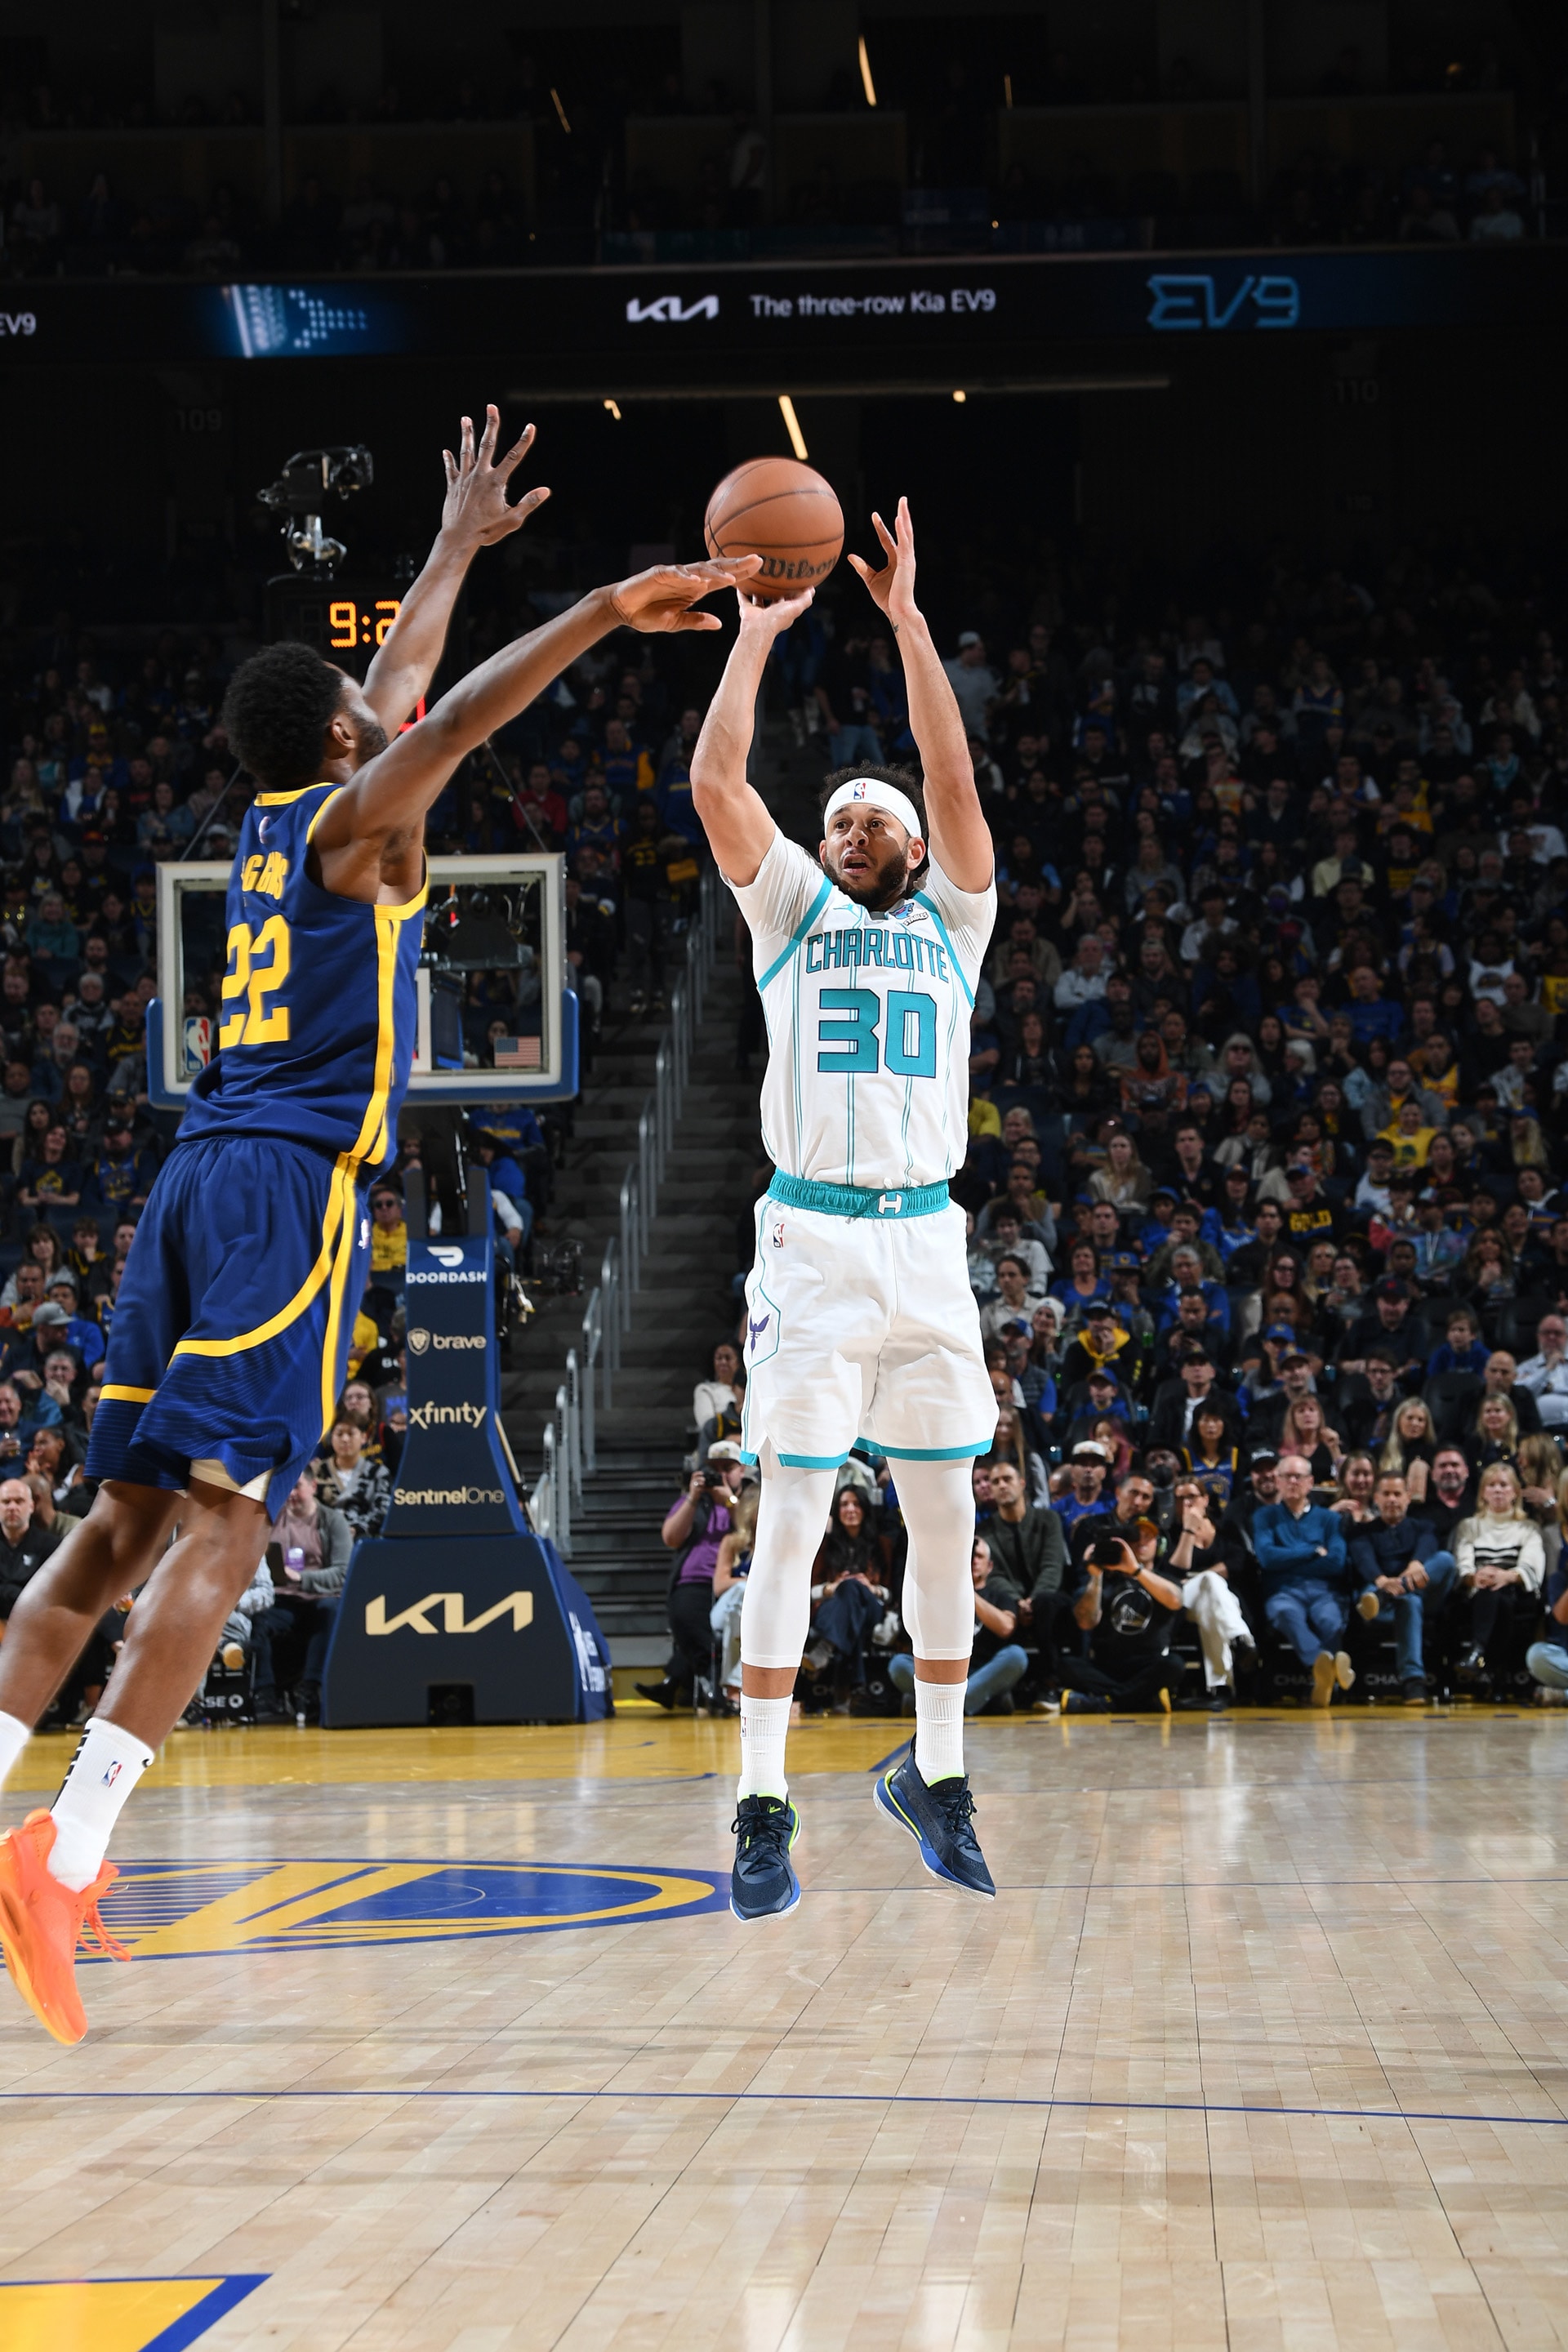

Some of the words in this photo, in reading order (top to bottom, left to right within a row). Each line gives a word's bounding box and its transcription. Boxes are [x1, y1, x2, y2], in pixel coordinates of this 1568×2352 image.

[751, 295, 792, 317] The
[797, 294, 905, 316] three-row
[910, 291, 946, 312] Kia
[951, 288, 996, 312] EV9
[1147, 274, 1298, 328] EV9
[176, 408, 222, 433] 109
[757, 555, 838, 580] Wilson
[329, 600, 402, 648] 9:2
[805, 928, 950, 984] CHARLOTTE
[219, 914, 291, 1050] 22
[817, 988, 938, 1079] 30
[406, 1271, 488, 1285] DOORDASH
[432, 1333, 488, 1351] brave
[409, 1401, 488, 1430] xfinity
[394, 1486, 506, 1507] SentinelOne
